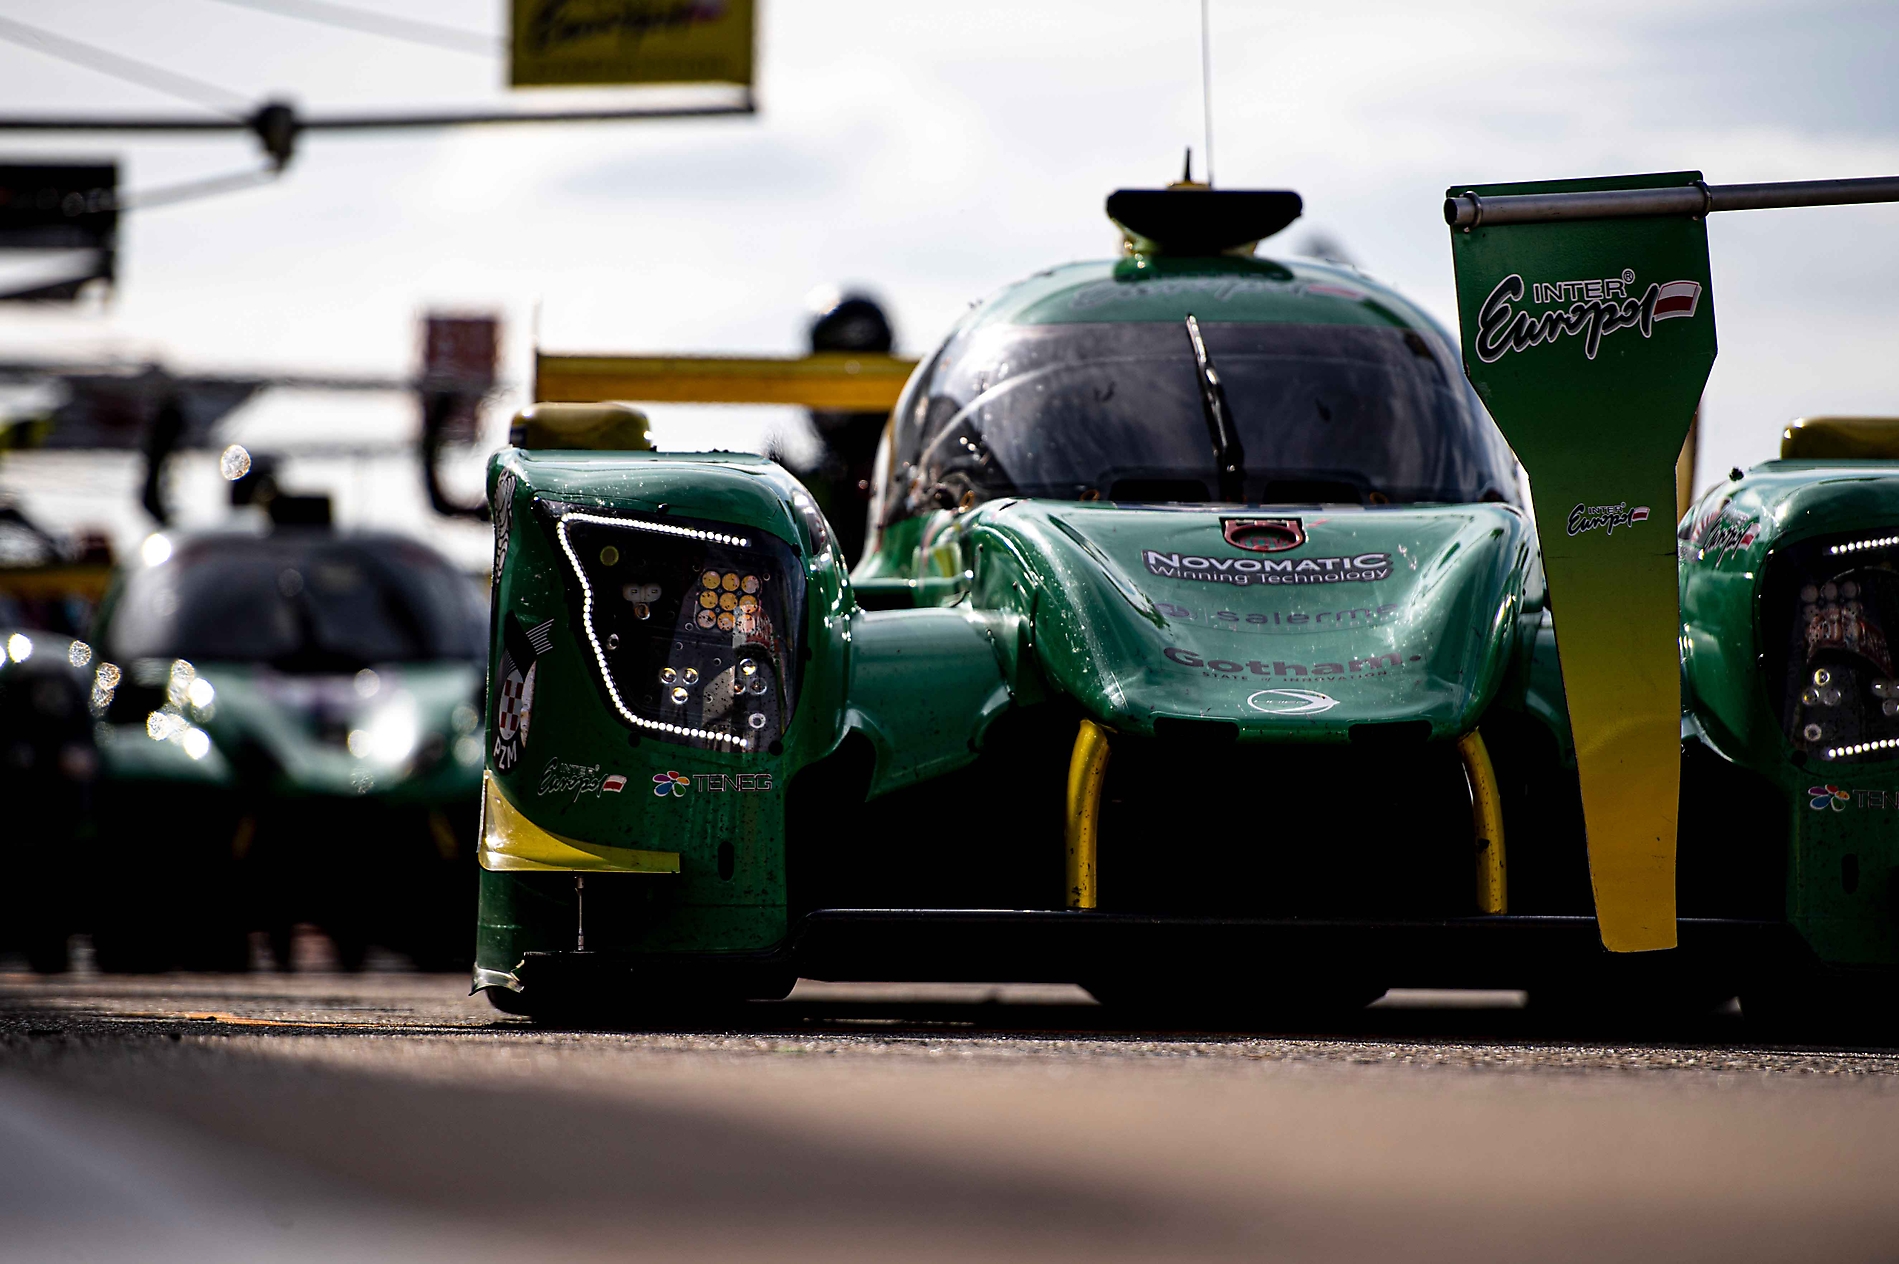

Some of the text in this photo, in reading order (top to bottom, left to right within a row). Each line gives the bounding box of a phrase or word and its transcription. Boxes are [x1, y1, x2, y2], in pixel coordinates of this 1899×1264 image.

[1475, 273, 1660, 363] Europol
[1566, 502, 1635, 536] Europol
[1147, 553, 1387, 572] NOVOMATIC
[1150, 565, 1388, 584] Winning Technology
[493, 736, 517, 769] PZM
[692, 773, 773, 793] TENEG
